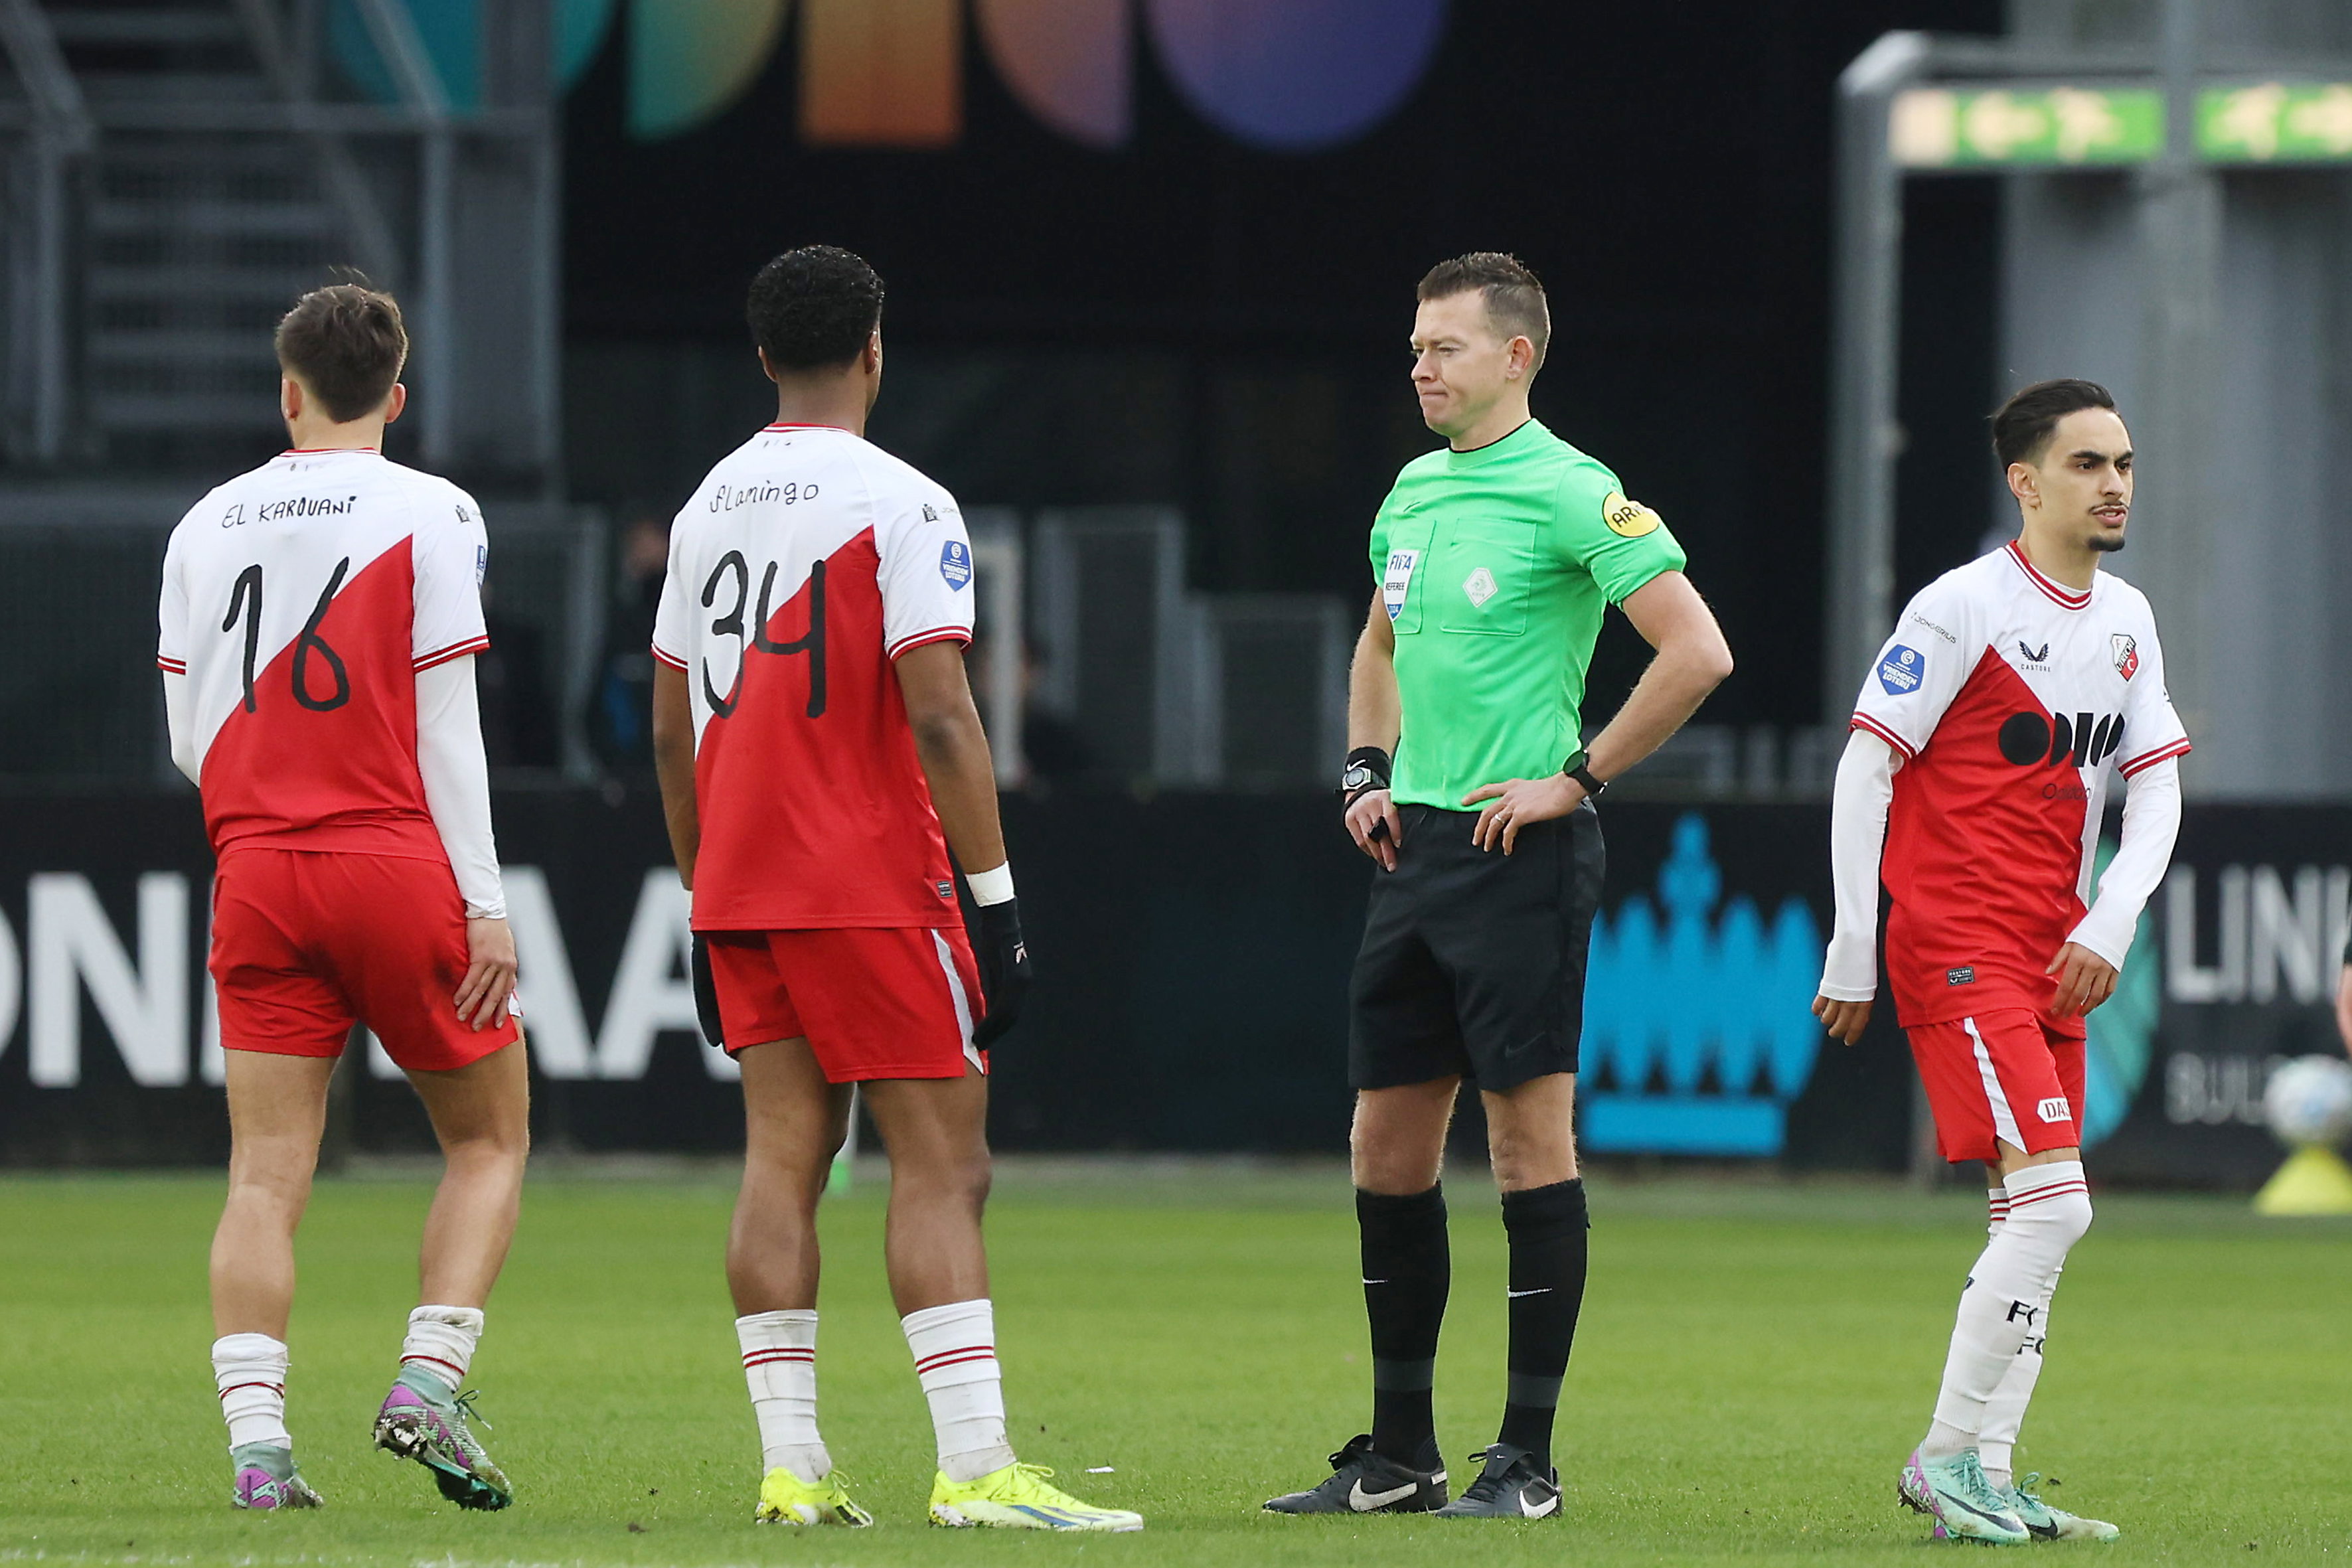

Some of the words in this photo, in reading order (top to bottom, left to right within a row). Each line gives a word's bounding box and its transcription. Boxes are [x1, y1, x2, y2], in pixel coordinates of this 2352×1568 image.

[222, 504, 246, 528] EL
[1611, 506, 1641, 528] AR
[1389, 554, 1412, 570] FIFA
[222, 556, 351, 714] 16
[701, 550, 826, 720] 34
